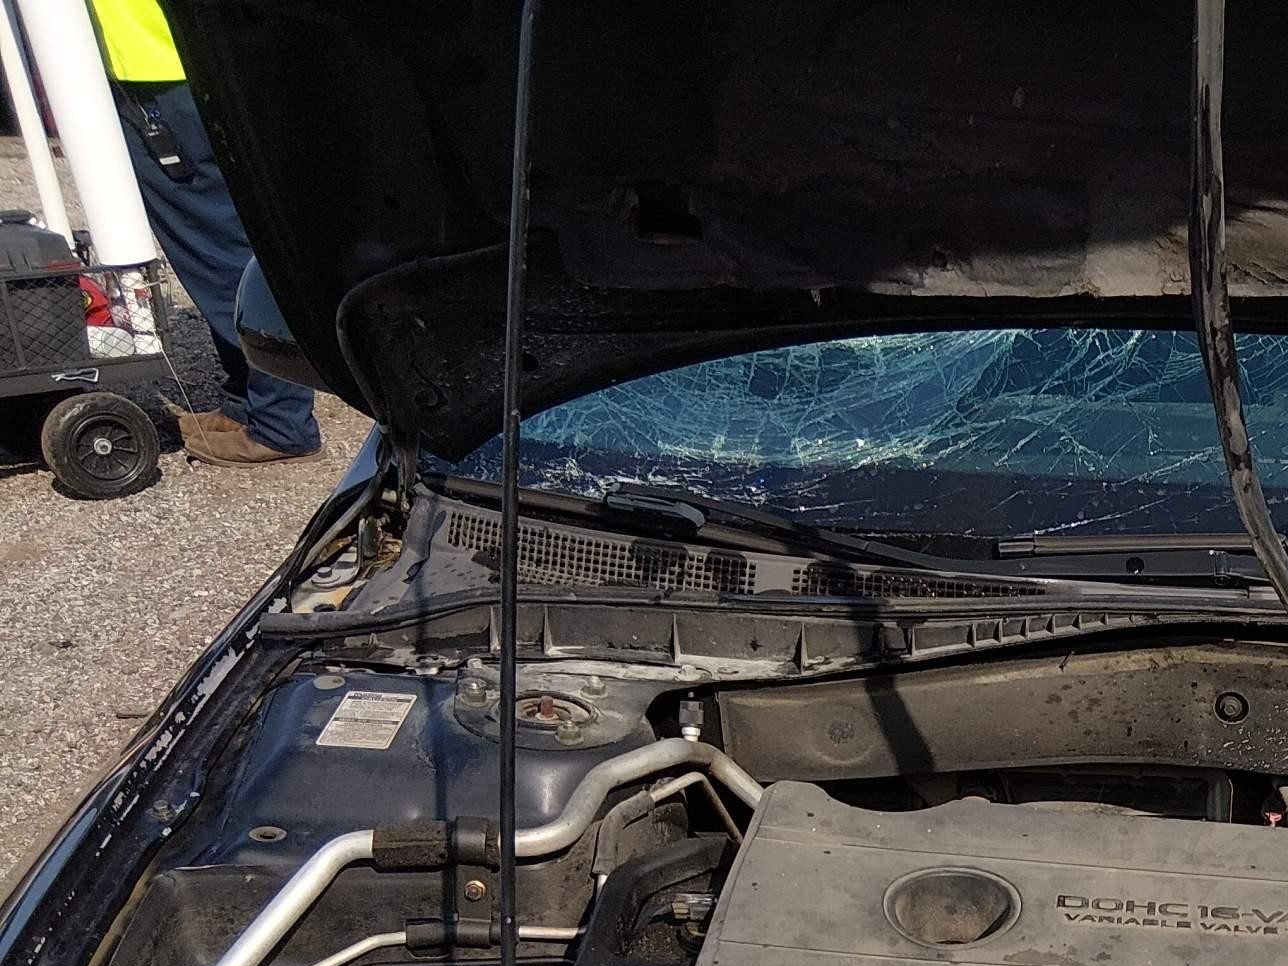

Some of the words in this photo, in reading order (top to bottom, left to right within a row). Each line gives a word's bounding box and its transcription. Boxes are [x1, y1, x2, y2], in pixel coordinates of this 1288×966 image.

[1057, 894, 1189, 918] DOHC
[1064, 912, 1192, 929] VARIABLE
[1200, 922, 1278, 935] VALVE
